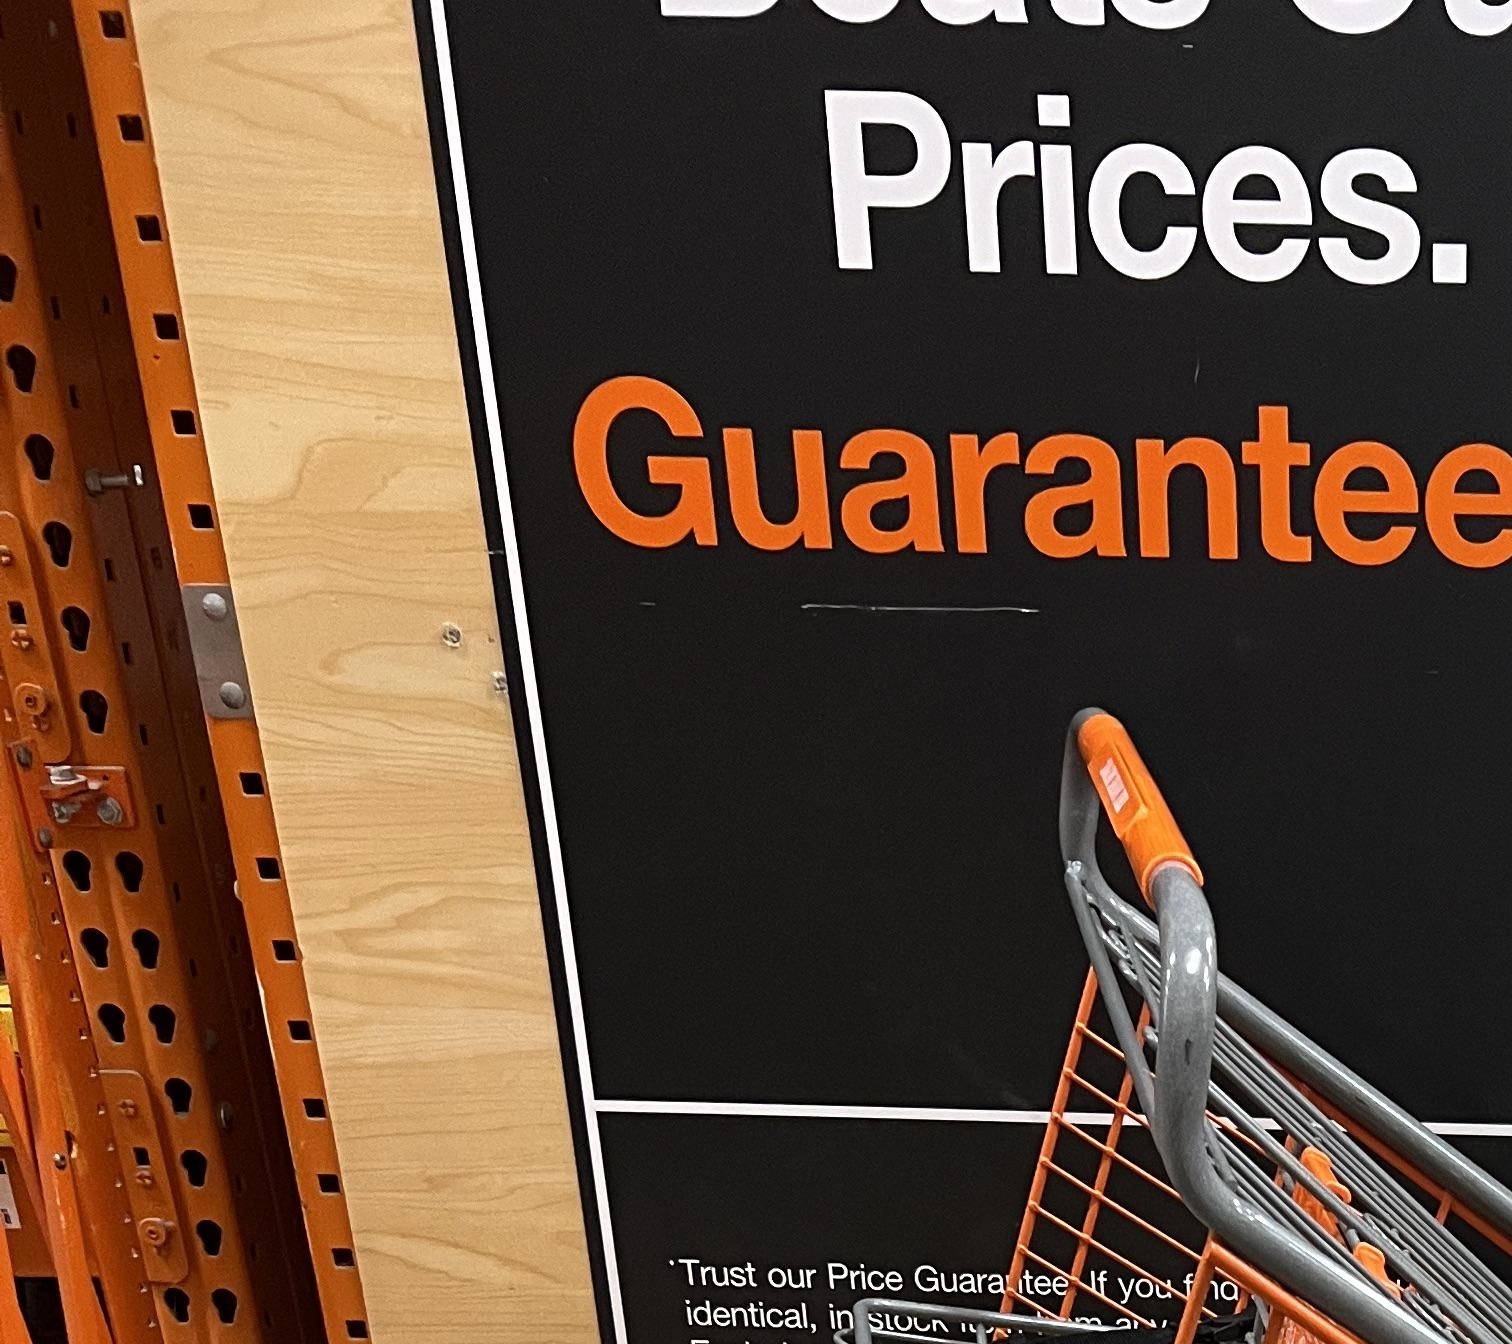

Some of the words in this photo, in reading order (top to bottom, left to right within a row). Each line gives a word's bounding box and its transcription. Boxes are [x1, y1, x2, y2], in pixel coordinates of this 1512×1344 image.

[824, 88, 1468, 284] Prices.
[678, 1258, 757, 1289] Trust
[767, 1268, 816, 1289] our
[827, 1263, 903, 1291] Price
[914, 1264, 1069, 1296] Guaratee
[1090, 1270, 1108, 1296] If
[1117, 1277, 1172, 1304] you
[1183, 1273, 1239, 1300] fnd
[685, 1300, 817, 1334] identical,
